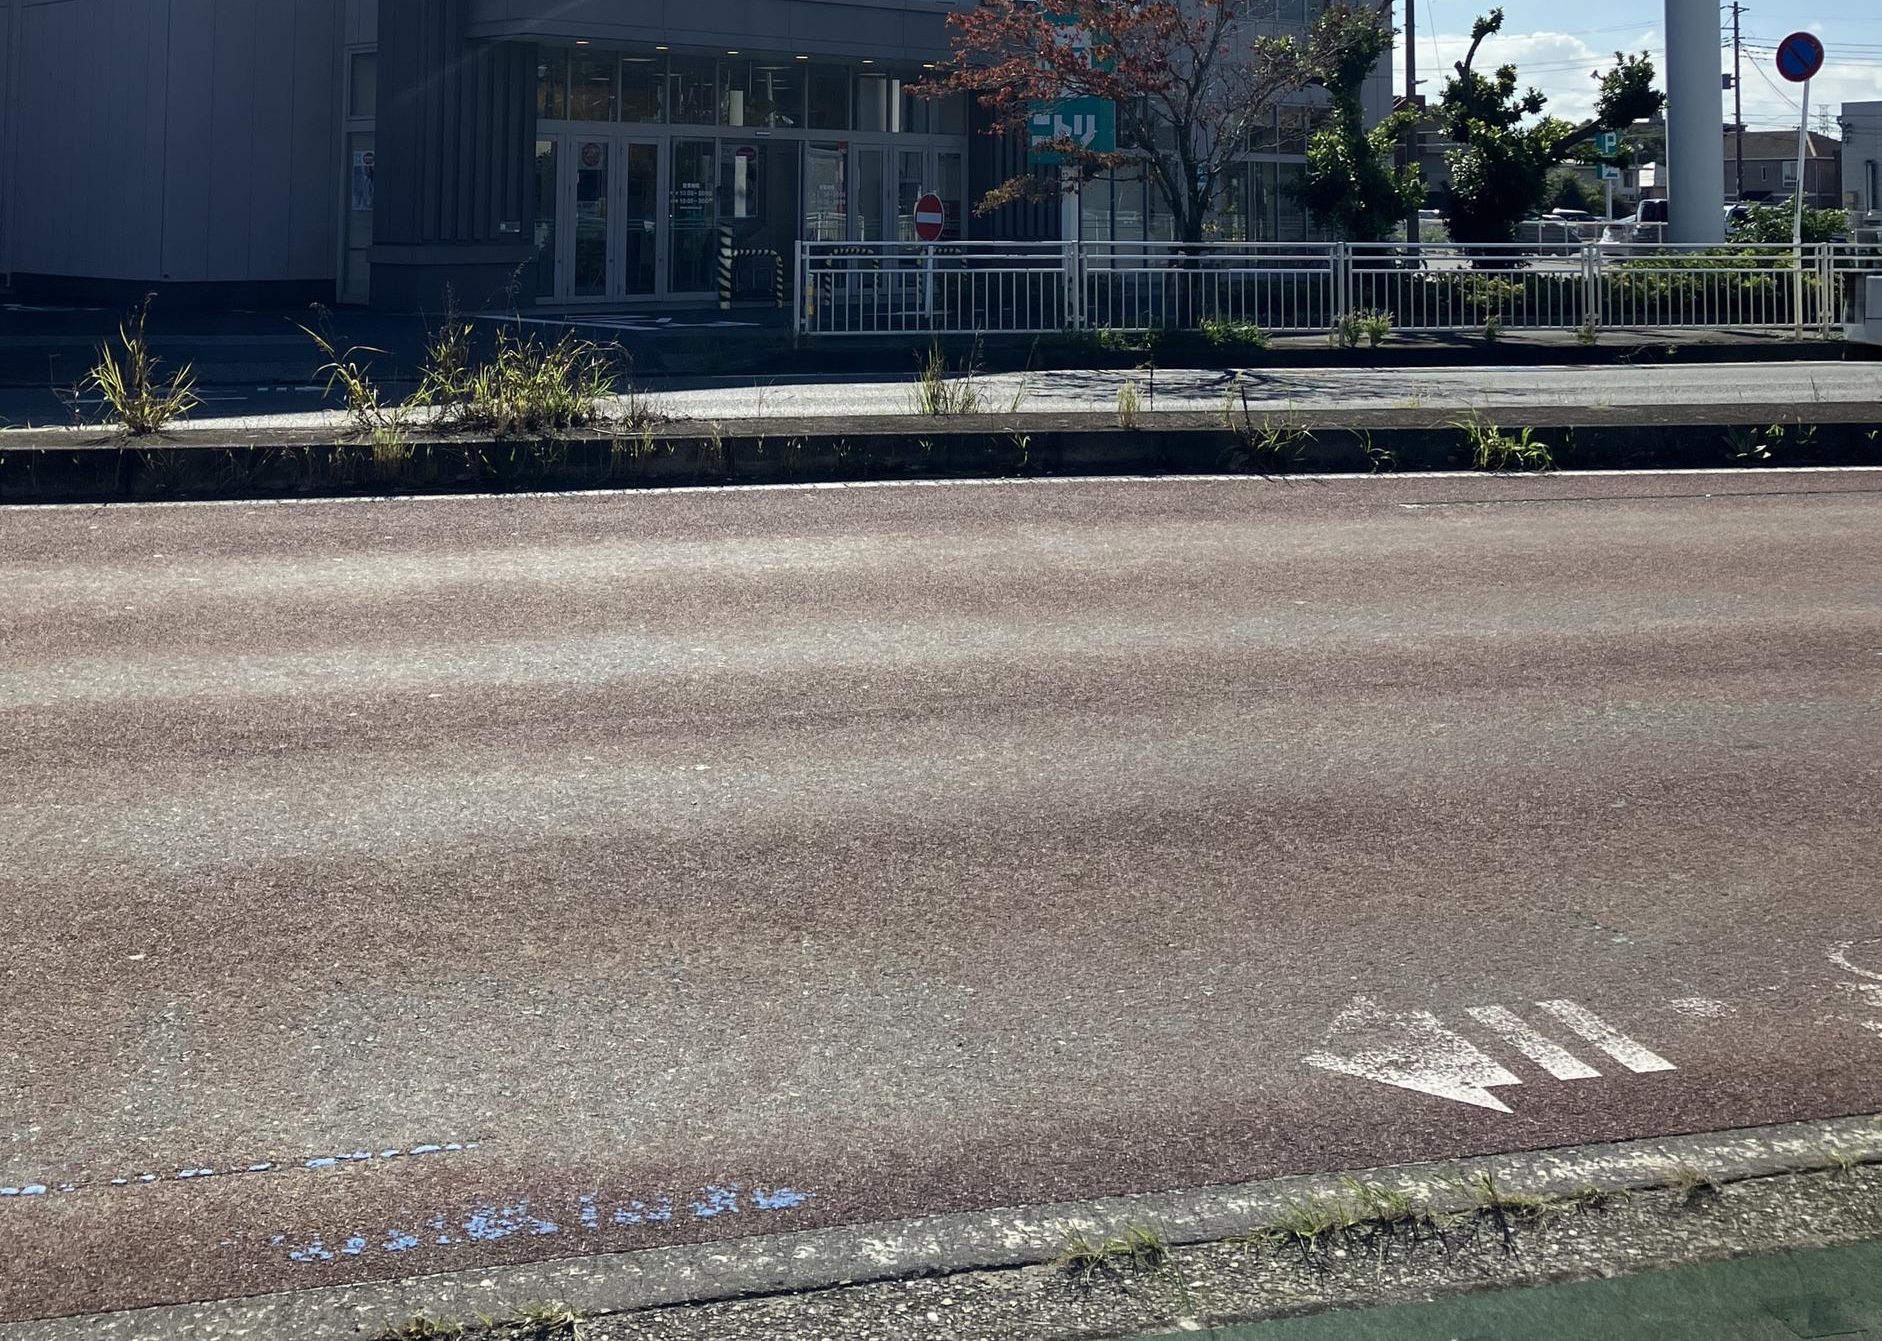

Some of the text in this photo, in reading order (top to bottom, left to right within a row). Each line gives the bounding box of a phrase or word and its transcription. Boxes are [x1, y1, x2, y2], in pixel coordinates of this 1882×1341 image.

[1032, 113, 1096, 150] ニトリ
[1605, 132, 1617, 153] P
